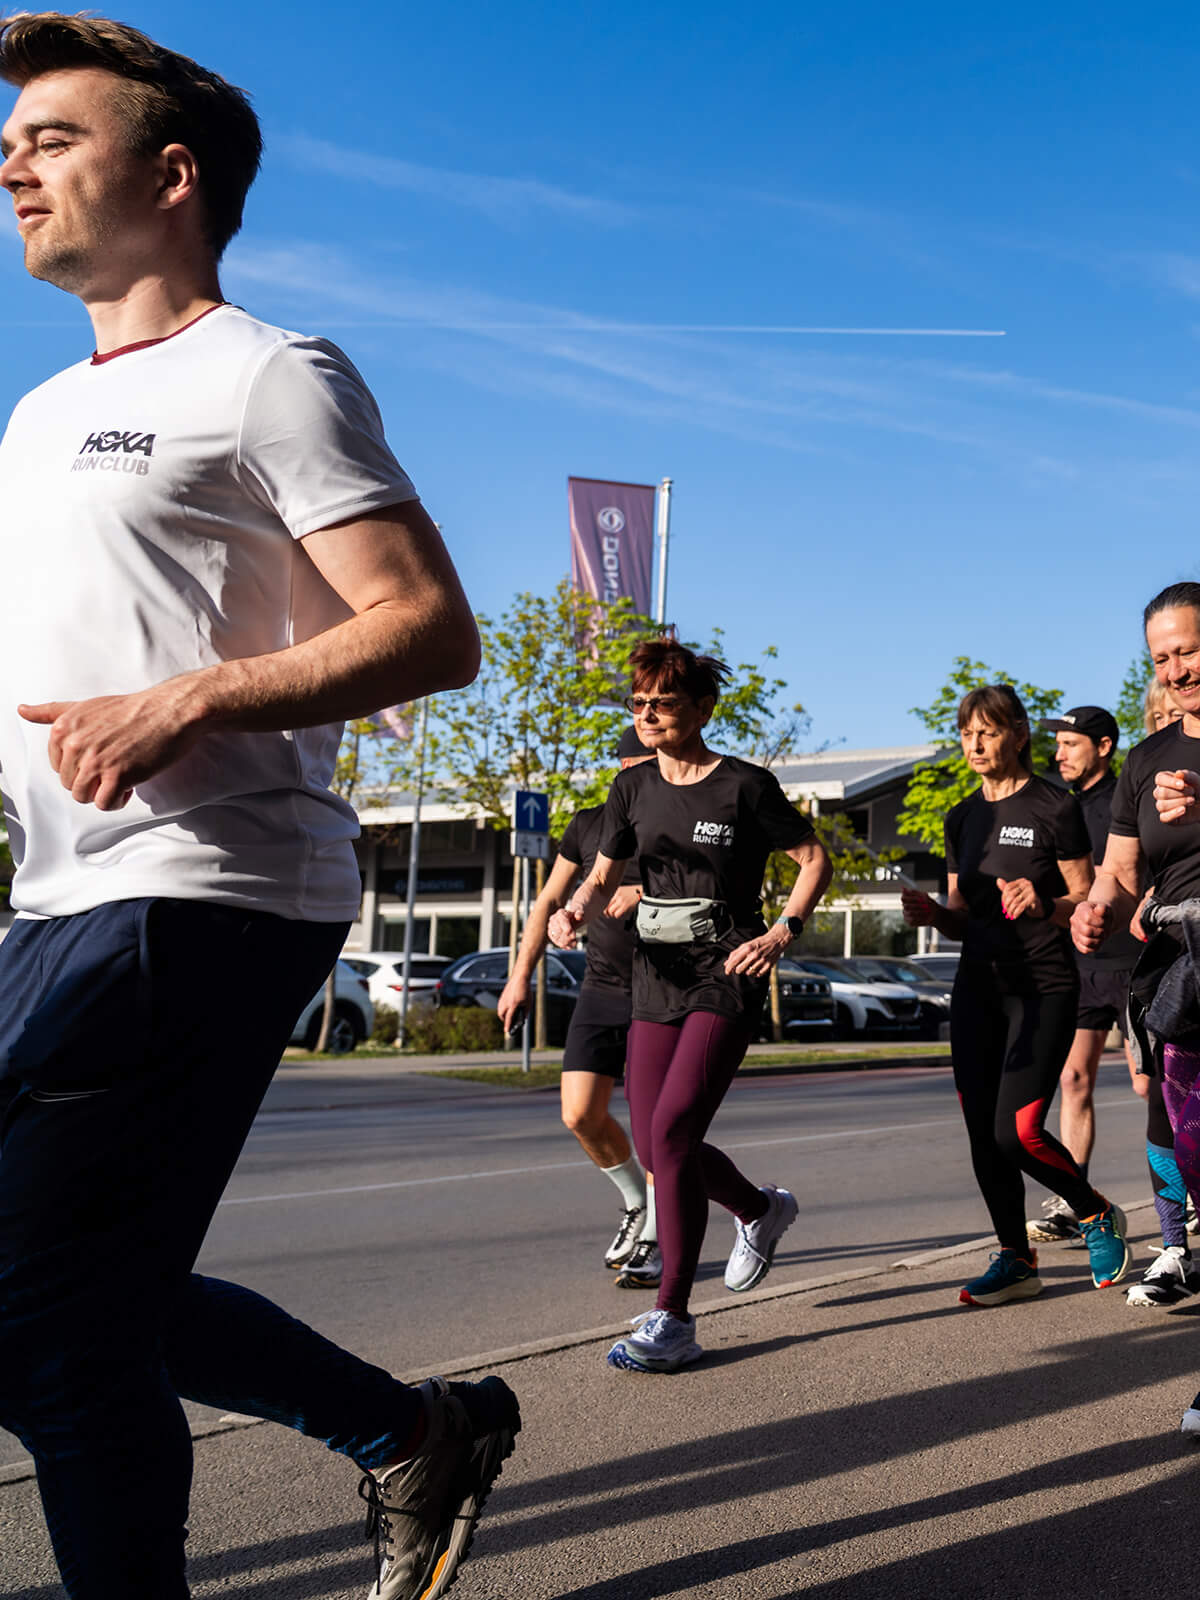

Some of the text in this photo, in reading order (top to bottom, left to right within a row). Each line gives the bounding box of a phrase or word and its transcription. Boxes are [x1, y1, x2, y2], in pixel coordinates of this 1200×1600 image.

[79, 431, 156, 456] HOKA
[71, 456, 149, 476] RUN CLUB
[694, 820, 734, 837] HOKA
[1000, 826, 1034, 840] HOKA
